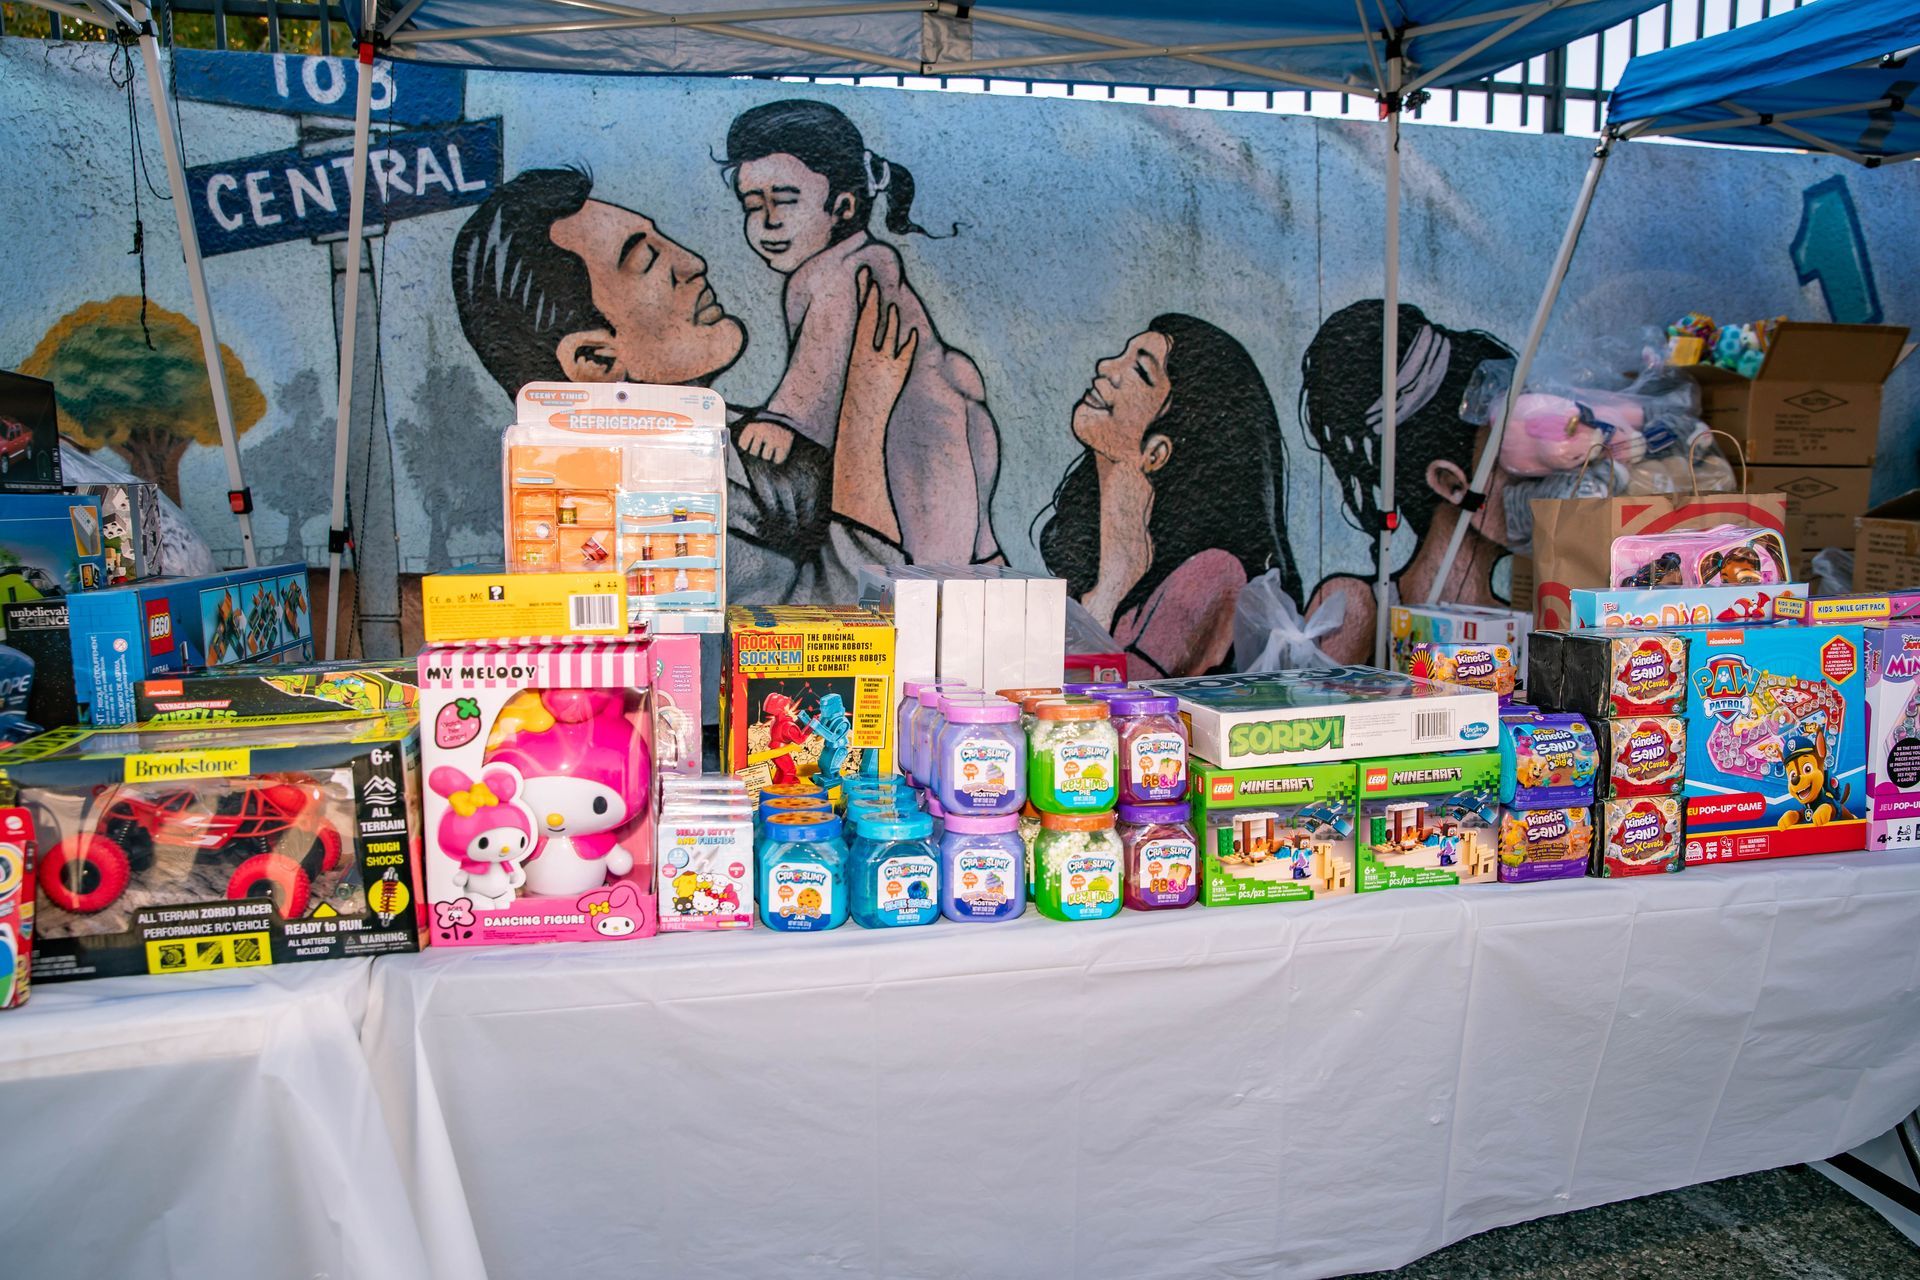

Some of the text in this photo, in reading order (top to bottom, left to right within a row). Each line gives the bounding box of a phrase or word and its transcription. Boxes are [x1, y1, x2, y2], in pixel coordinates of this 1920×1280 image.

[206, 144, 487, 231] CENTRAL
[569, 413, 677, 431] REFRIGERATOR
[151, 615, 169, 638] LEGO
[740, 635, 802, 650] ROCK'EM
[822, 633, 855, 641] ORIGINAL
[807, 642, 873, 650] FIGHTING ROBOTS!
[740, 651, 801, 665] SOCK'EM
[807, 654, 887, 662] LES PREMIERS ROBOTS
[1456, 652, 1490, 664] Kinetic
[1632, 653, 1662, 667] Kinetic
[427, 666, 536, 680] MY MELODY
[807, 664, 850, 672] DE COMBAT!
[1692, 665, 1762, 698] PAW
[1710, 700, 1745, 711] PATROL
[230, 716, 277, 724] TERRAIN
[1230, 717, 1344, 756] SORRY!
[1534, 731, 1571, 742] Kinetic
[1630, 734, 1662, 748] Kinetic
[371, 749, 393, 766] 6+
[135, 758, 238, 777] Brookstone
[1142, 773, 1178, 788] PB&J
[1368, 768, 1462, 785] LEGO MINECRAFT
[1214, 778, 1314, 794] LEGO MINECRAFT
[372, 807, 392, 818] ALL
[1737, 802, 1762, 812] GAME
[1527, 812, 1564, 826] Kinetic
[1624, 814, 1656, 830] Kinetic
[360, 819, 405, 832] TERRAIN
[707, 828, 736, 836] KITTY
[698, 837, 736, 845] FRIENDS
[1877, 834, 1892, 844] 4+
[367, 842, 400, 854] TOUGH
[366, 855, 404, 867] SHOCKS
[1364, 866, 1376, 874] 6+
[1150, 878, 1188, 894] PB&J
[1212, 878, 1224, 886] 6+
[1389, 875, 1414, 887] pcs/pzs
[1238, 888, 1266, 900] pcs/pzs
[138, 904, 272, 924] ALL TERRAIN ZORRO RACER
[449, 913, 462, 922] 6+
[484, 914, 585, 927] DANCING FIGURE
[144, 920, 270, 938] PERFORMANCE R/C VEHICLE
[285, 923, 322, 936] READY
[325, 921, 337, 932] to
[288, 937, 336, 947] ALL BATTERIES
[360, 932, 408, 944] WARNING:
[296, 946, 329, 956] INCLUDED
